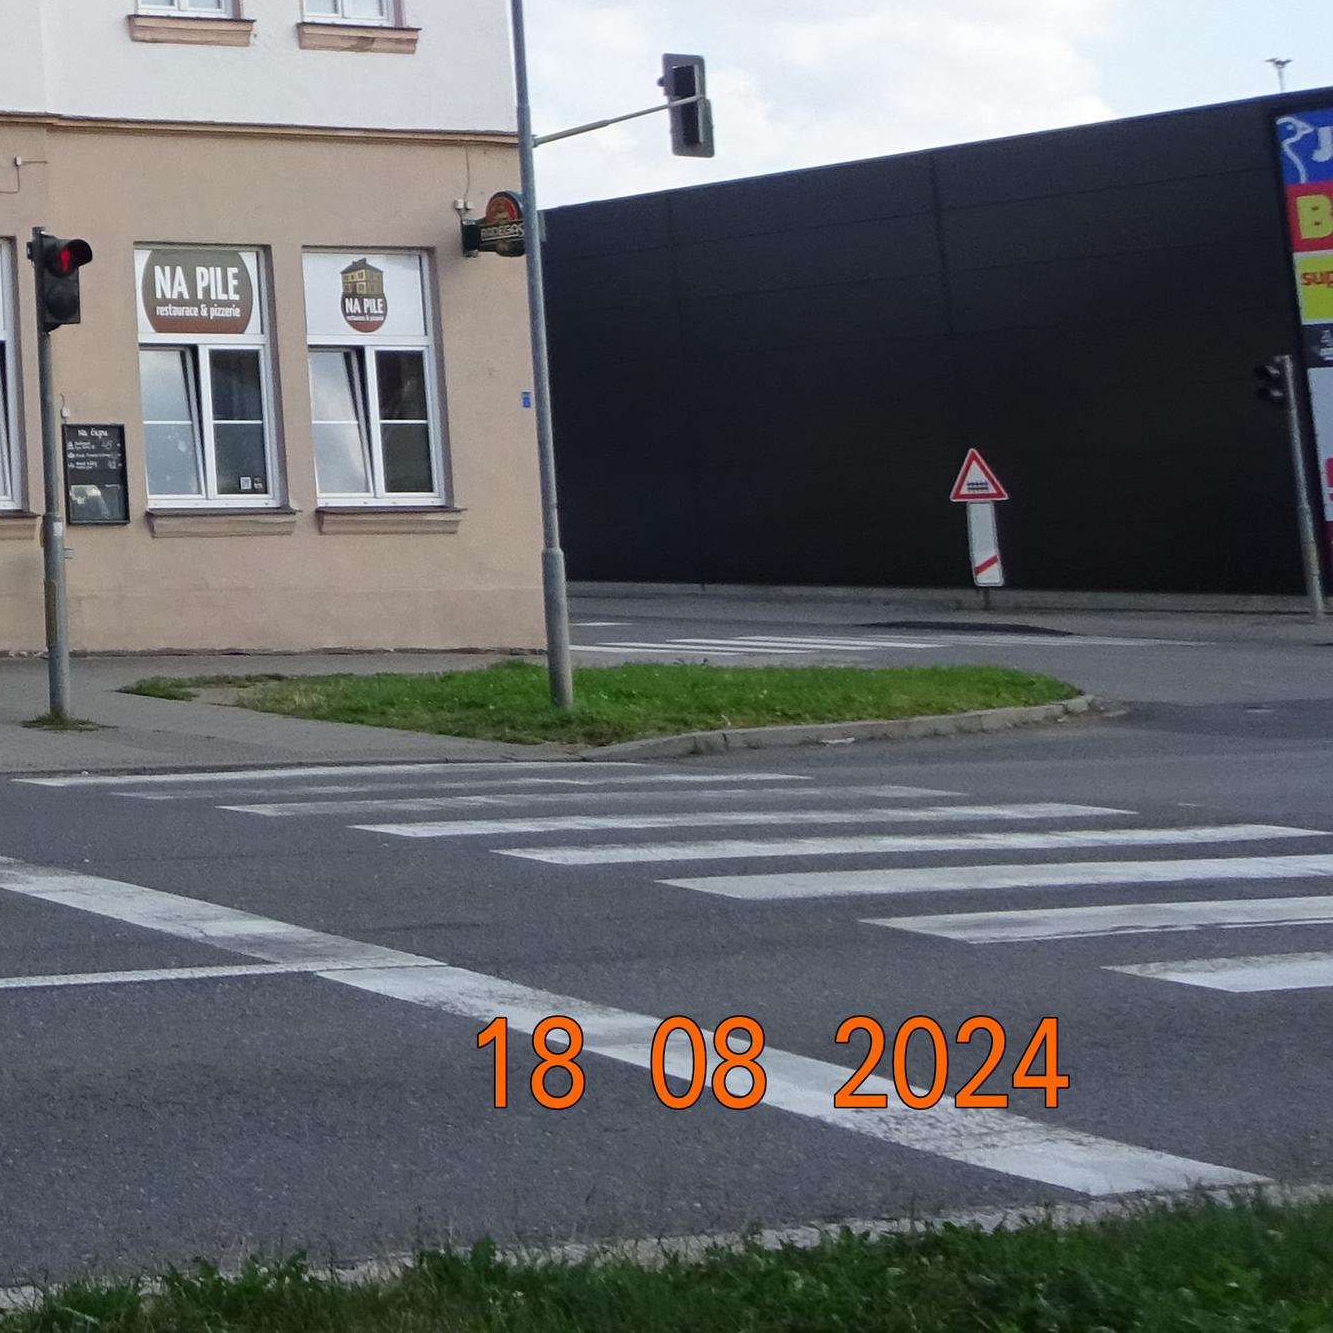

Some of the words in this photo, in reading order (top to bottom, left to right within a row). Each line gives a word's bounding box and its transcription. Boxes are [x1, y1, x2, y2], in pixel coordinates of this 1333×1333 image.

[154, 265, 190, 299] NA
[196, 266, 240, 301] PILE
[156, 303, 199, 317] restaurace
[200, 304, 208, 317] &
[209, 304, 241, 320] pizzerie
[345, 297, 361, 314] NA
[363, 298, 384, 314] PILE
